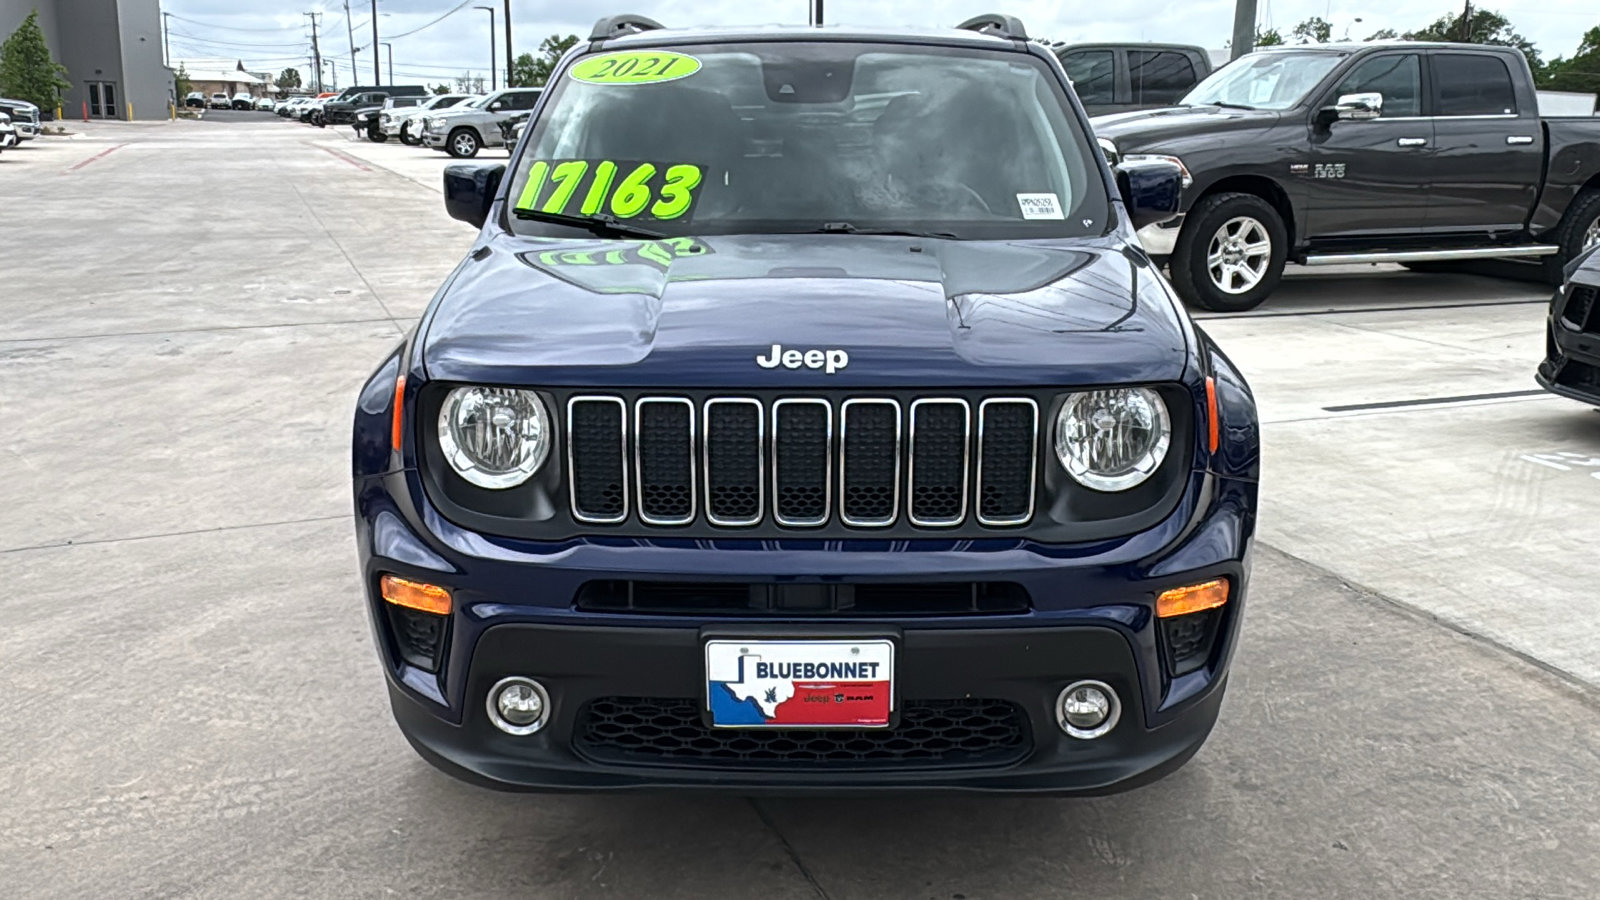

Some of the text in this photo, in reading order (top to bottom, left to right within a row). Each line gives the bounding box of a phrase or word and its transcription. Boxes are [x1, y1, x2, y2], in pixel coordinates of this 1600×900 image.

[590, 57, 679, 78] 2021
[516, 160, 702, 220] 17163
[756, 344, 848, 374] Jeep
[756, 662, 880, 679] BLUEBONNET
[804, 694, 829, 704] Jeep
